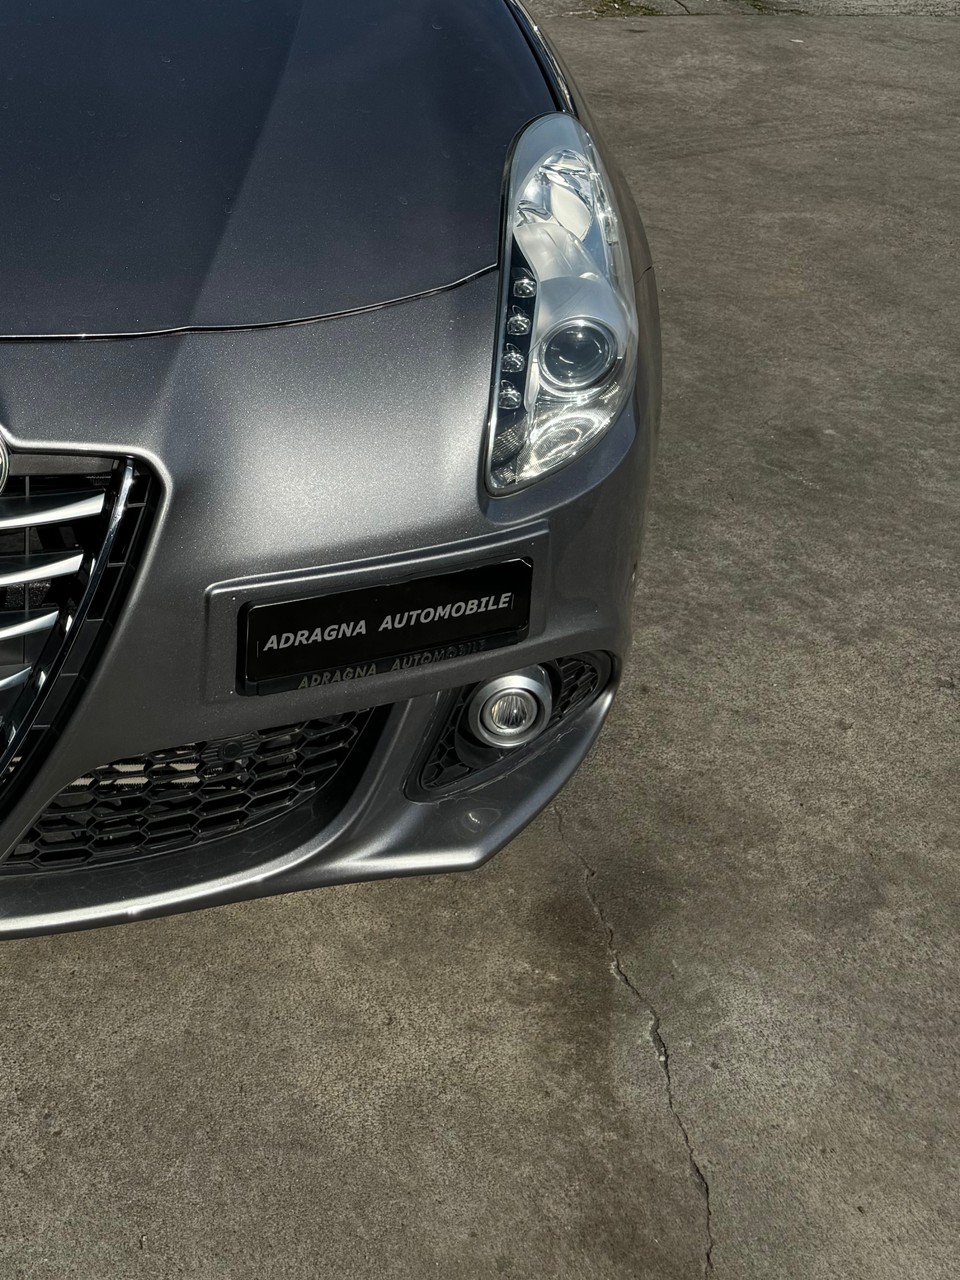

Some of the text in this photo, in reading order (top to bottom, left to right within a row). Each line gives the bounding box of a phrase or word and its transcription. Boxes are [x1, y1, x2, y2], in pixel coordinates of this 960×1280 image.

[263, 592, 512, 651] ADRAGNA AUTOMOBILE
[297, 639, 487, 690] ADRAGNA AUTOMOBILE
